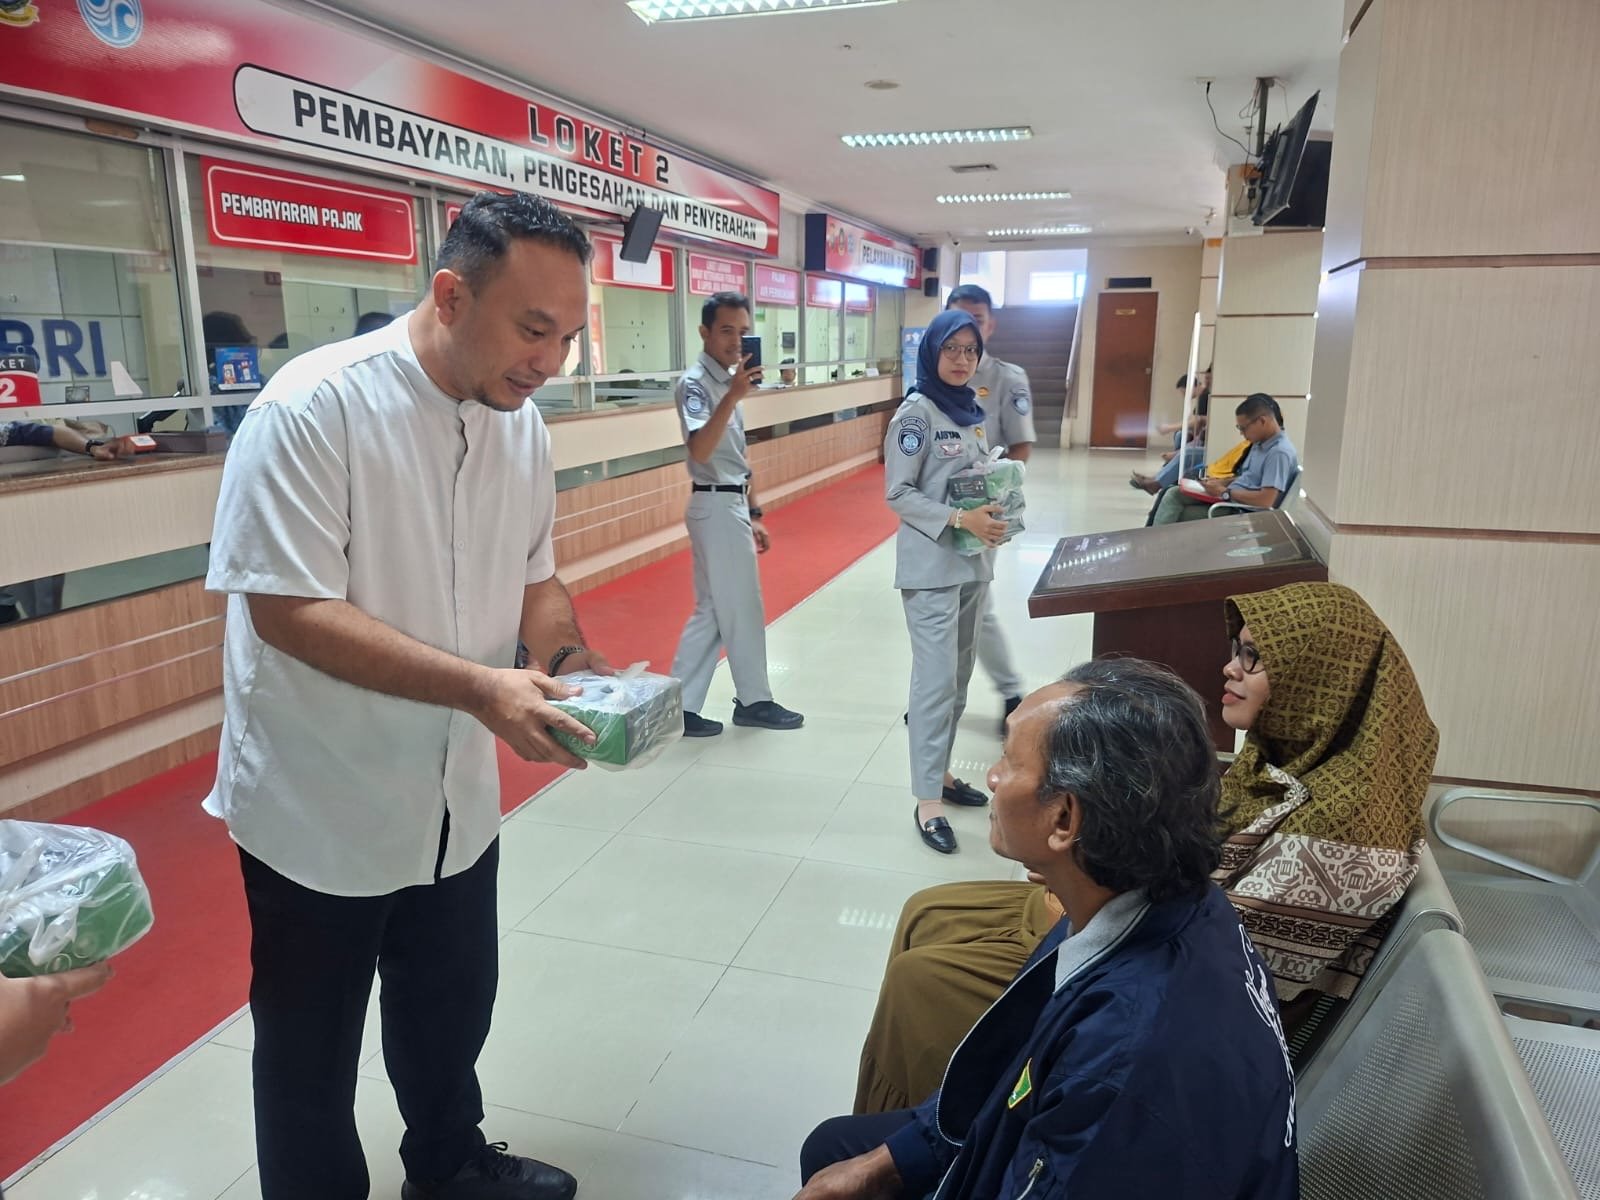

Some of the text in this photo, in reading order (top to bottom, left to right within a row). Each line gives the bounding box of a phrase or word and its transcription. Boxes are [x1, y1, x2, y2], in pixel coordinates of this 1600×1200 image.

[292, 89, 515, 182] PEMBAYARAN,
[523, 155, 646, 208] PENGESAHAN
[684, 203, 757, 241] PENYERAHAN
[528, 105, 669, 184] LOKET 2
[220, 192, 363, 232] PEMBAYARAN PAJAK
[0, 319, 107, 377] BRI
[0, 377, 18, 404] 2
